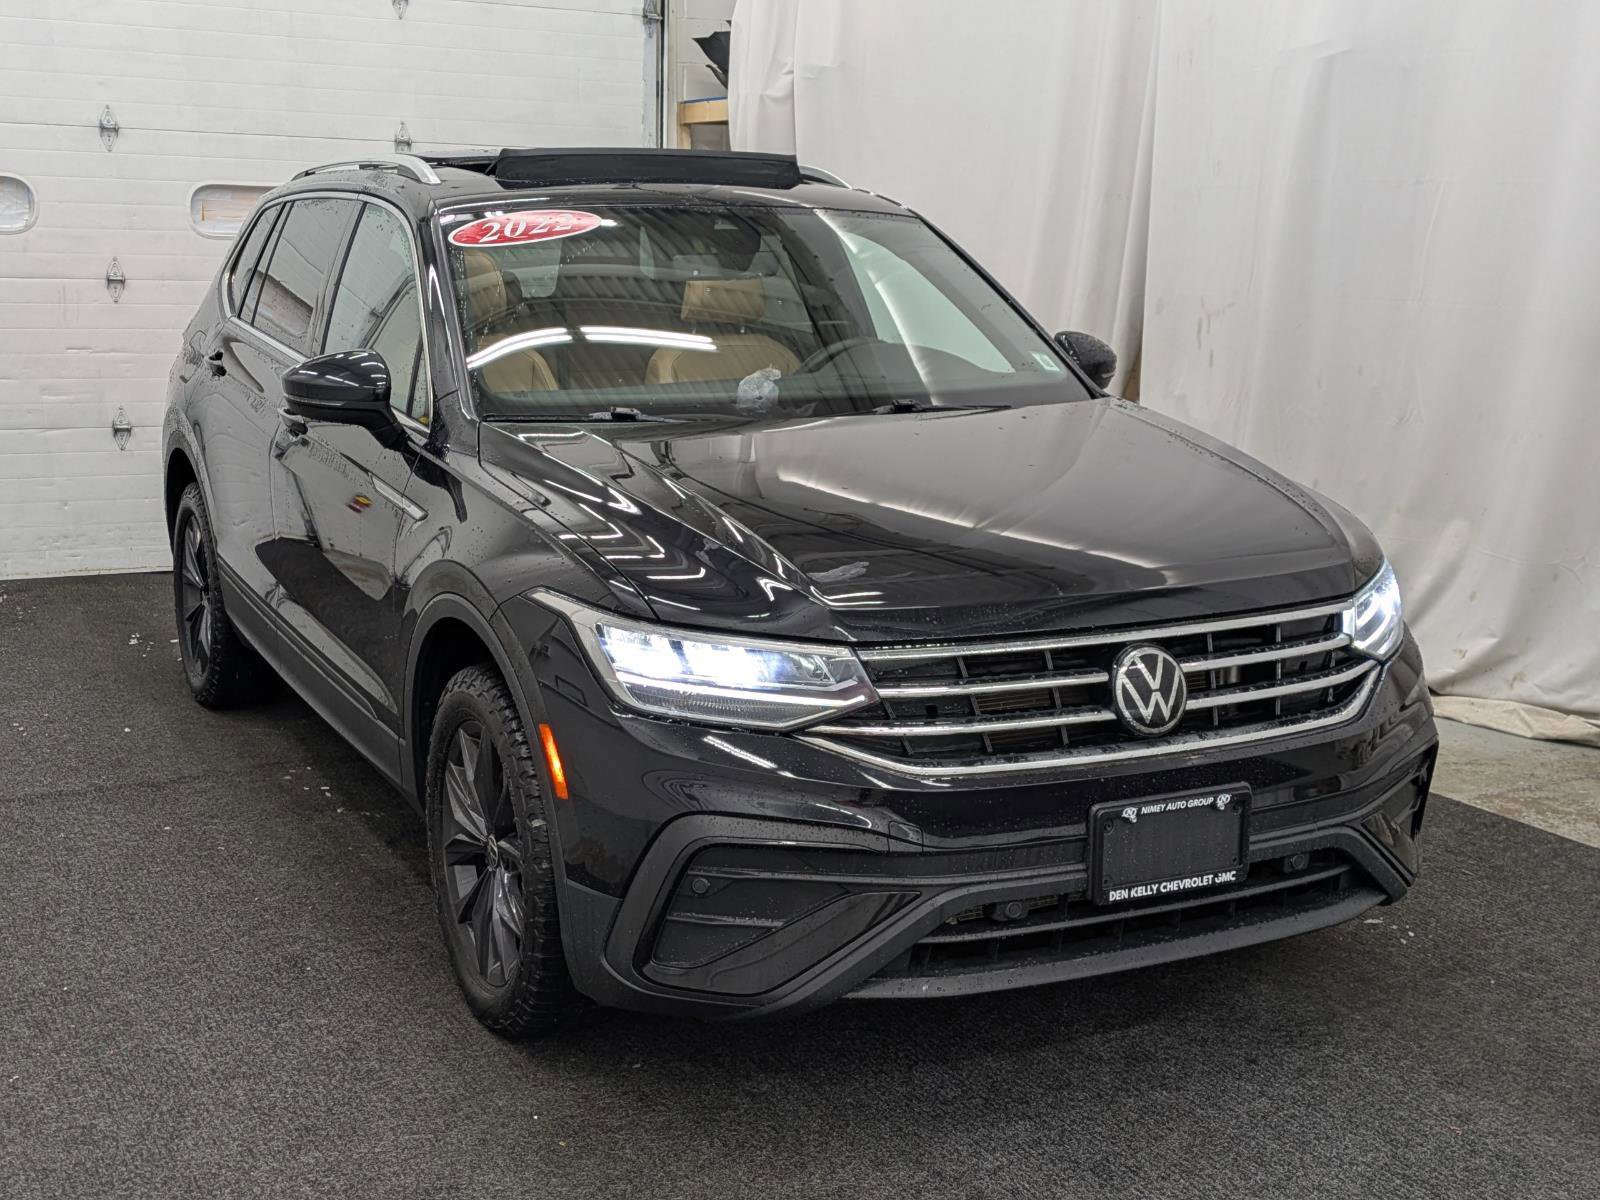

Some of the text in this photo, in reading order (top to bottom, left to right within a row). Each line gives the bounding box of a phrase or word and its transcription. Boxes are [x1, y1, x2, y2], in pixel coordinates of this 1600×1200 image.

[479, 213, 573, 243] 2022
[1119, 653, 1181, 725] VW
[1141, 803, 1166, 815] NIMEY
[1166, 801, 1187, 811] AUTO
[1187, 797, 1214, 808] GROUP
[1109, 890, 1129, 901] DEN
[1130, 883, 1159, 898] KELLY
[1160, 875, 1213, 892] CHEVROLET
